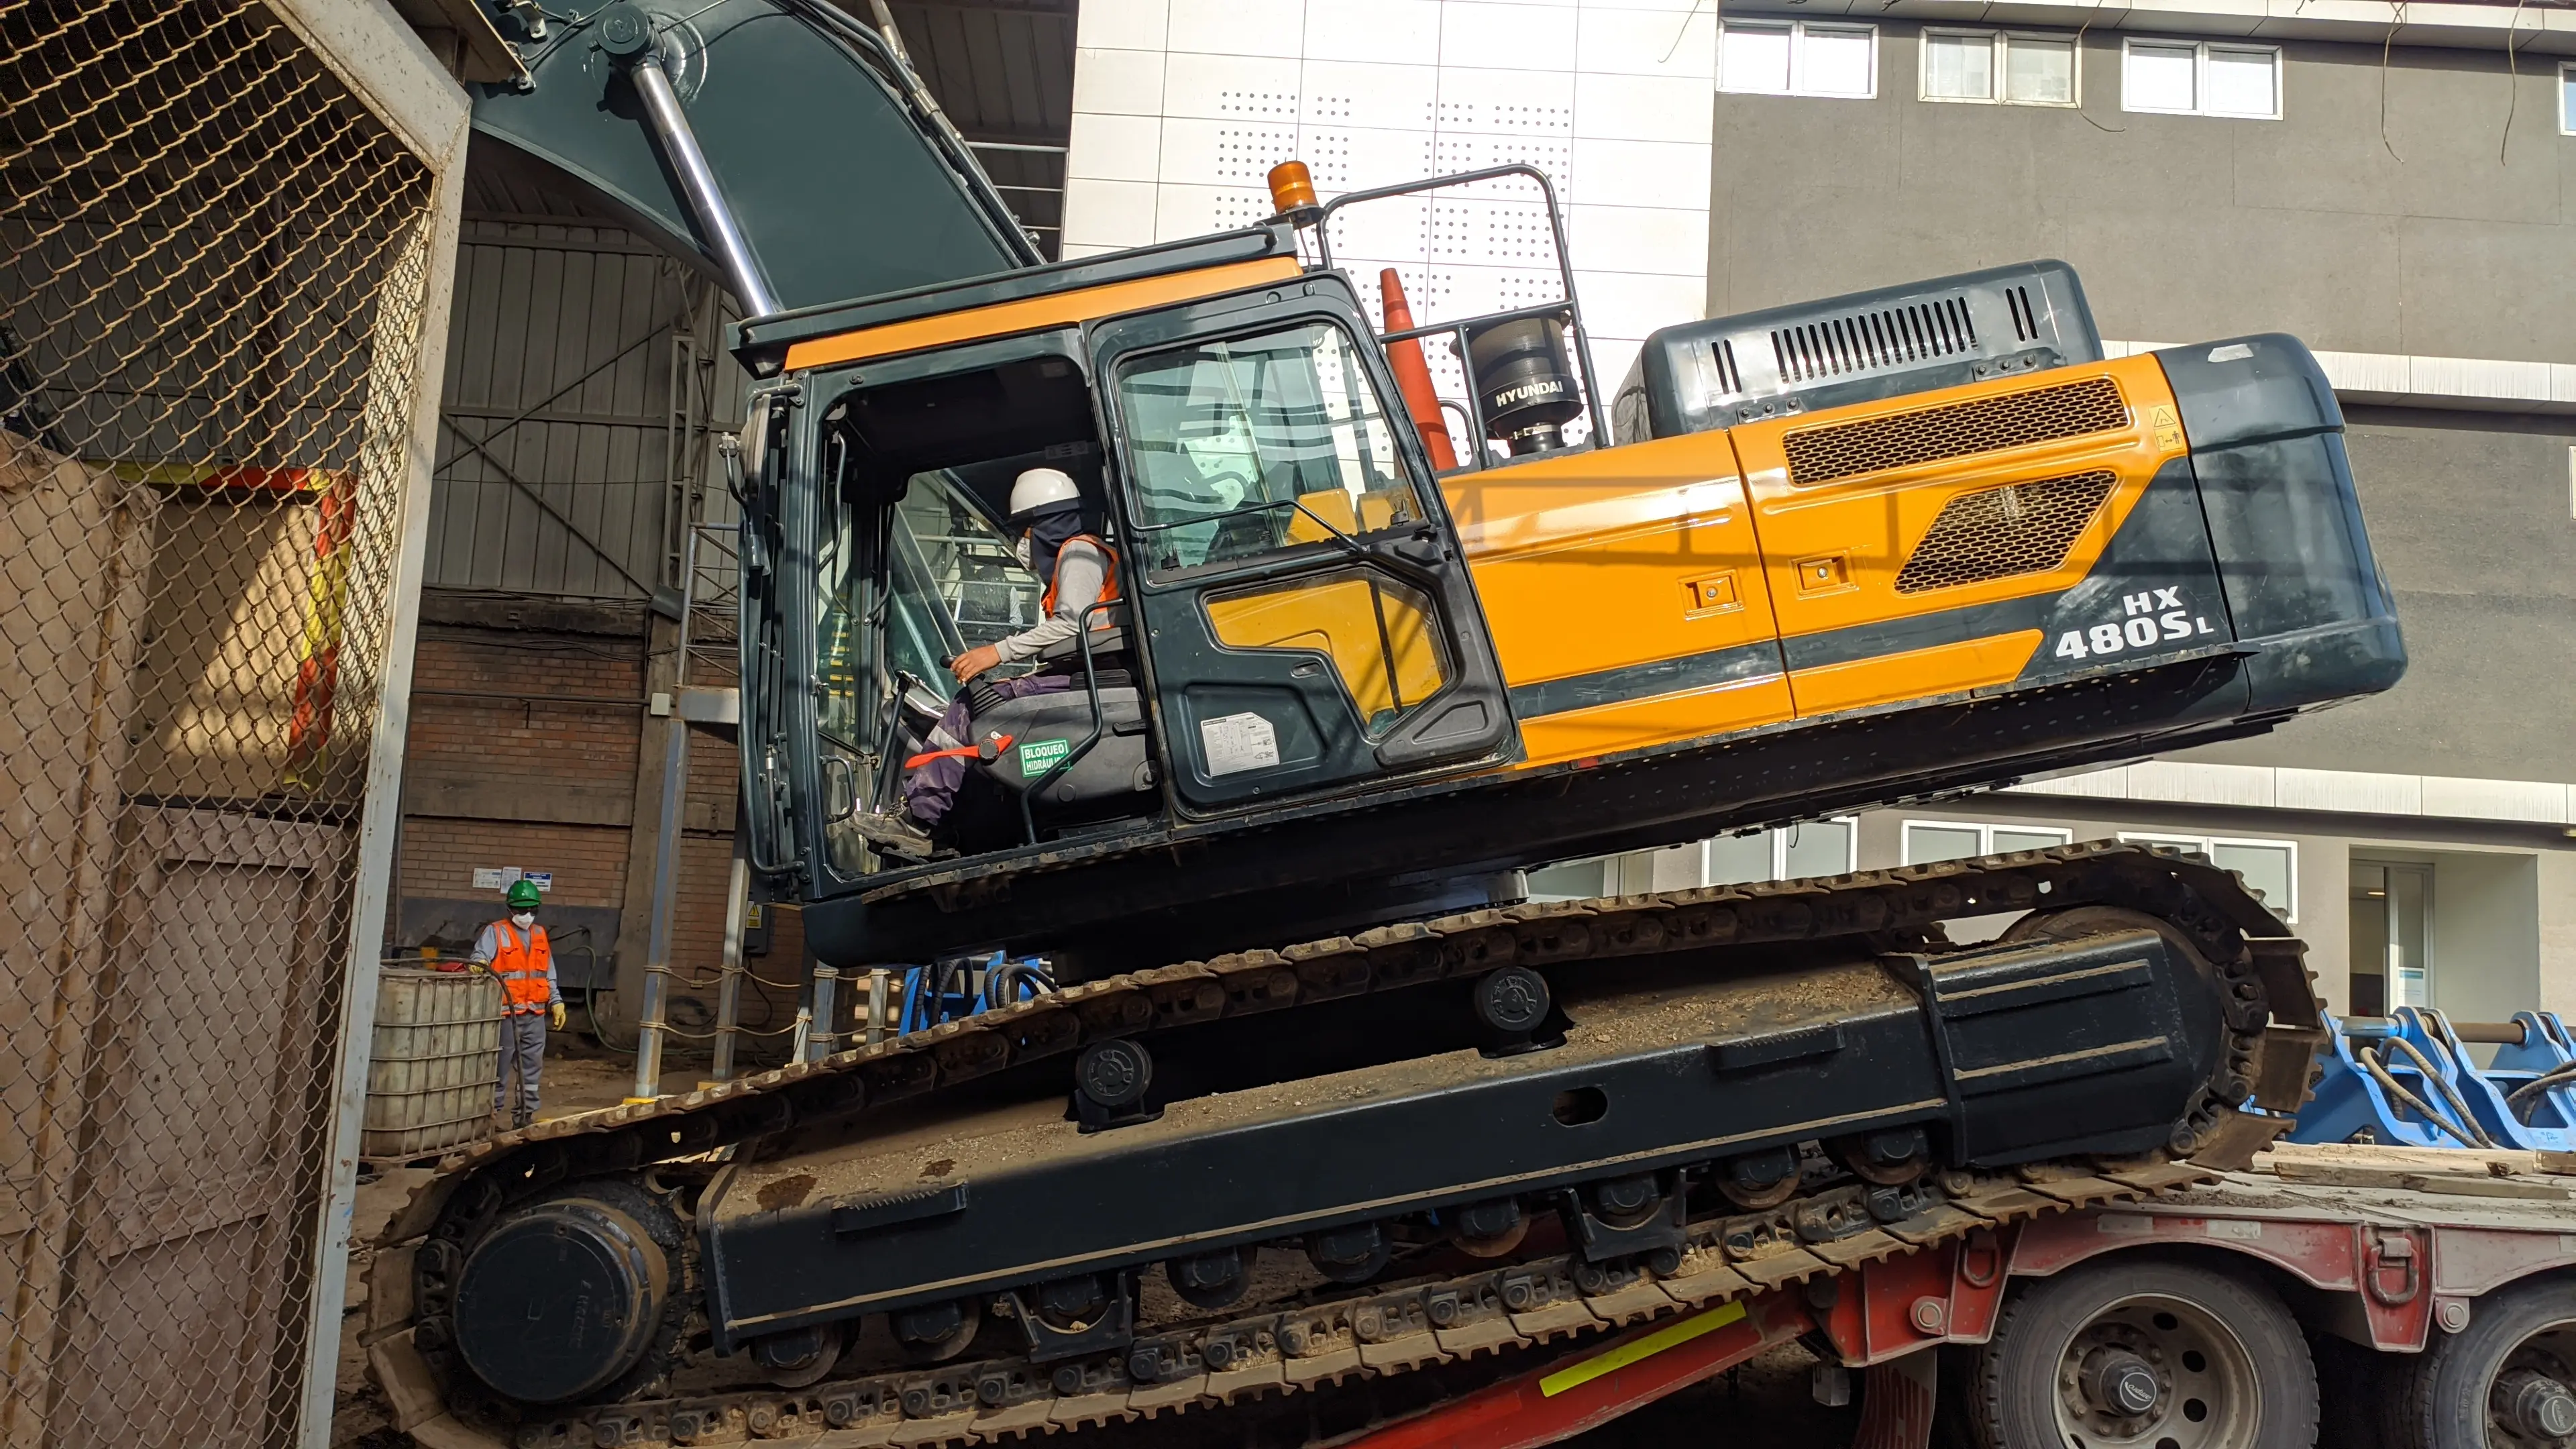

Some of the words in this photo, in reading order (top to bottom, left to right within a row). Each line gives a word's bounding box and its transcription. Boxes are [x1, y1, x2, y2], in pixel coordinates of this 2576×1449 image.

[1495, 380, 1564, 407] HYUNDAI
[2123, 585, 2184, 616] HX
[1024, 743, 1065, 759] BLOQUEO
